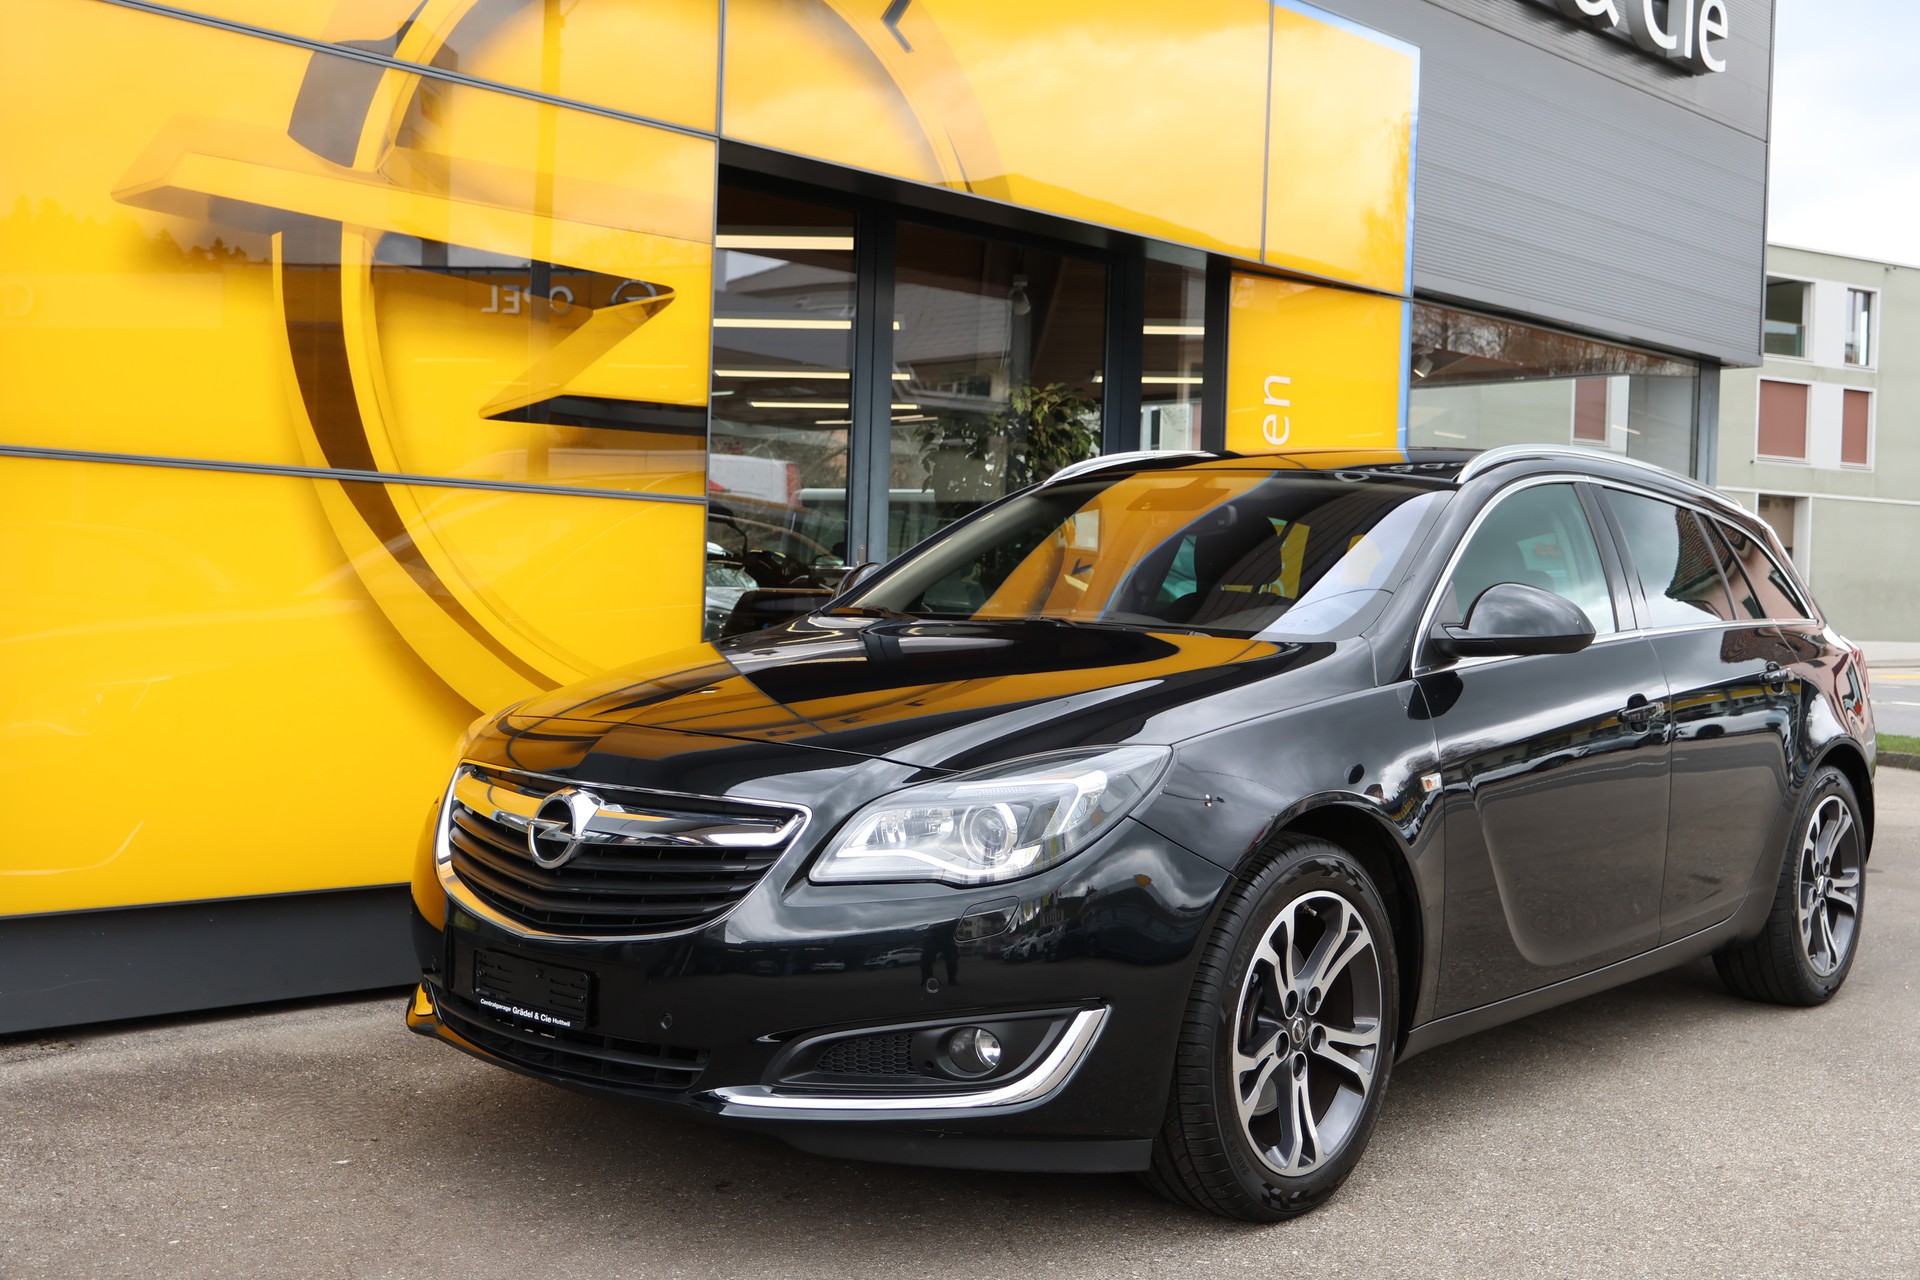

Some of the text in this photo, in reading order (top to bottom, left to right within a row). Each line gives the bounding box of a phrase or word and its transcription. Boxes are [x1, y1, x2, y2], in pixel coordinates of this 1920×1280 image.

[1263, 376, 1291, 449] en
[480, 998, 511, 1013] Centralgarage
[512, 1006, 533, 1019] Grädel
[534, 1012, 539, 1020] &
[540, 1013, 551, 1023] Cie
